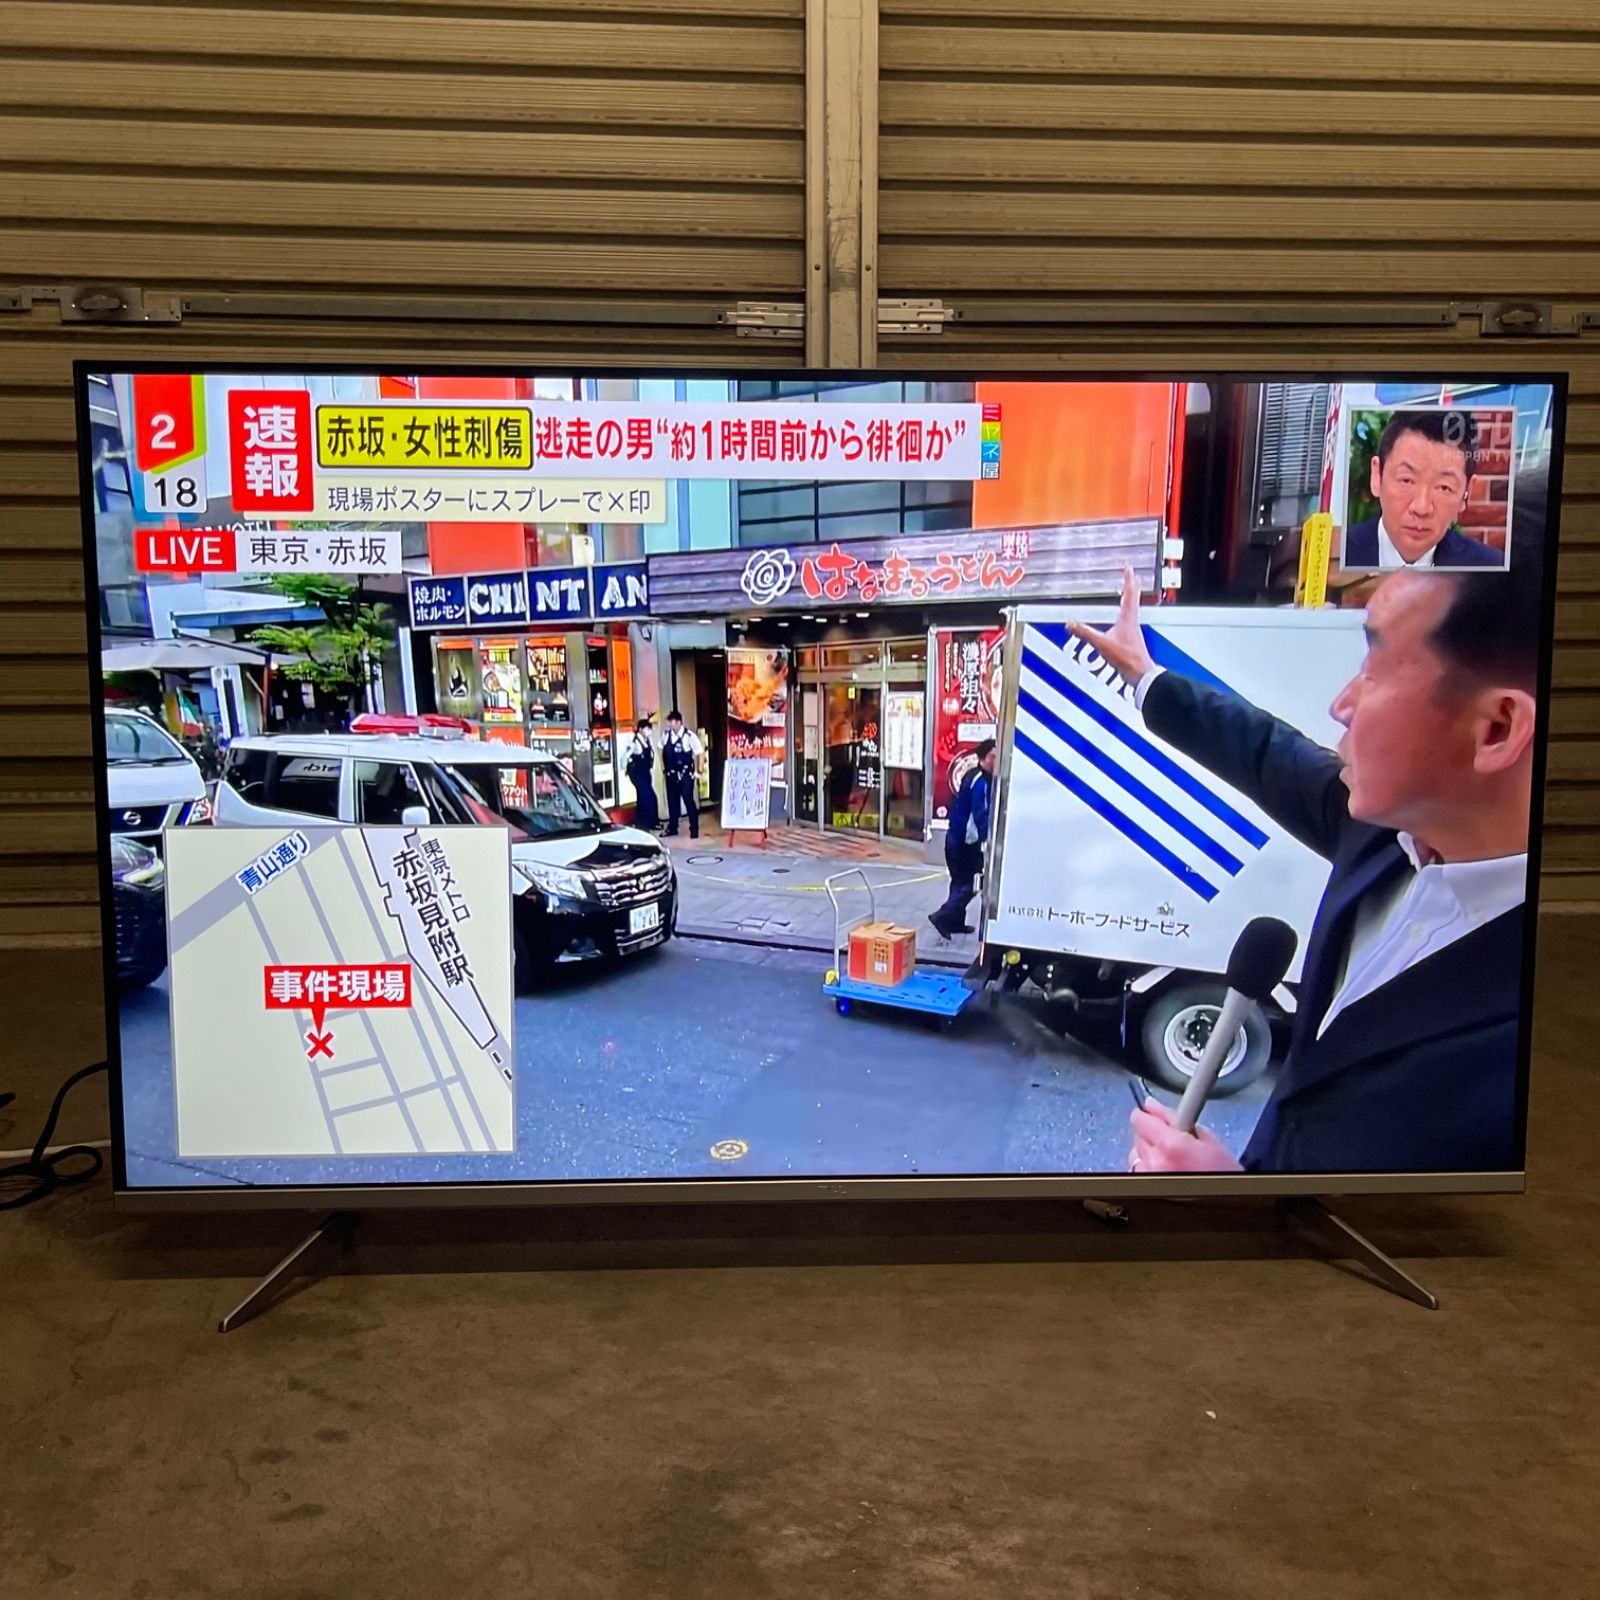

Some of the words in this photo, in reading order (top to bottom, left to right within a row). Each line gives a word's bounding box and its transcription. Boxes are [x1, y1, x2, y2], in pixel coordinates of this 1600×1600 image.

[150, 413, 176, 449] 2
[243, 404, 299, 498] 速報
[327, 415, 523, 459] 赤坂・女性刺傷
[154, 477, 198, 508] 18
[149, 537, 223, 565] LIVE
[250, 536, 387, 566] 東京・赤坂
[801, 542, 1024, 602] はなまるうどん
[237, 832, 310, 892] 青山通り
[421, 838, 471, 924] 東京メトロ
[393, 850, 474, 988] 赤坂見附駅
[1047, 906, 1191, 939] トーホーフードサービス
[269, 969, 406, 1003] 事件現場
